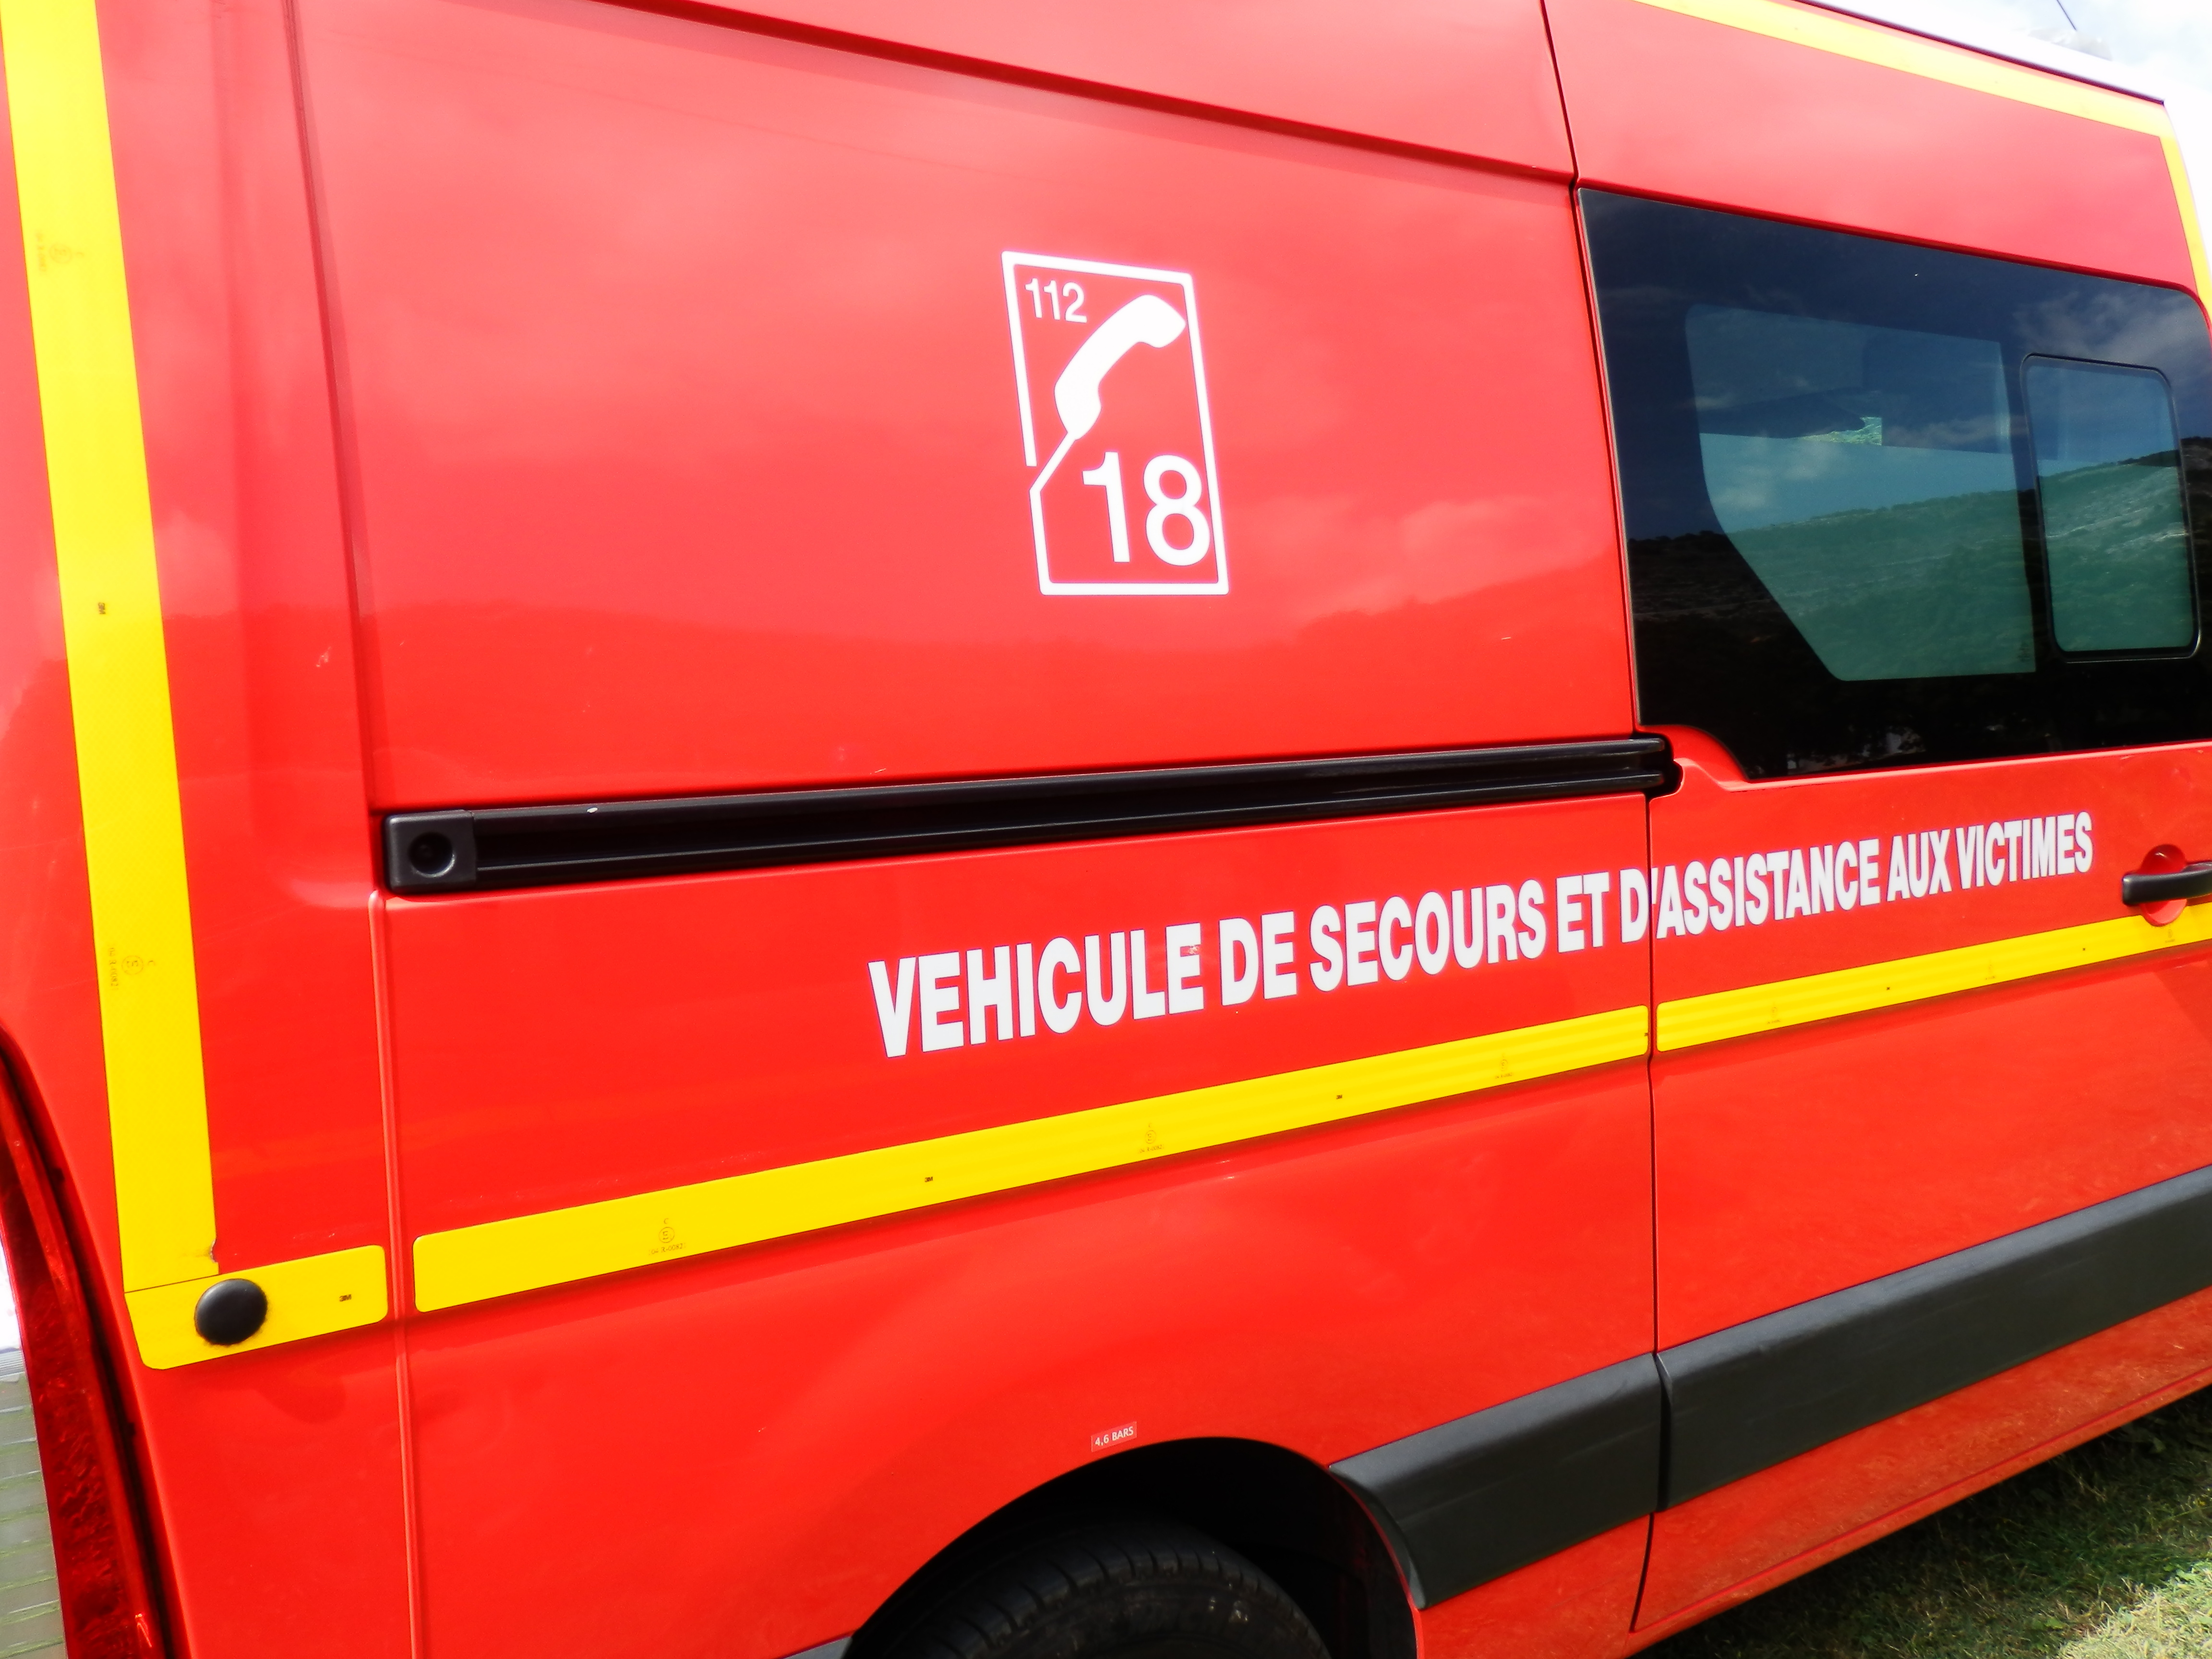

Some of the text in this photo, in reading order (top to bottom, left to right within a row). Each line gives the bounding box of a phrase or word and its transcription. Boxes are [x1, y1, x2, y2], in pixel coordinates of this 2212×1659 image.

[1024, 277, 1088, 324] 112
[1082, 451, 1212, 566] 18
[867, 811, 2093, 1058] VEHICULE DE SECOURS ET D'ASSISTANCE AUX VICTIMES
[339, 1294, 352, 1302] 3M
[1094, 1426, 1134, 1446] 4,6 BARS
